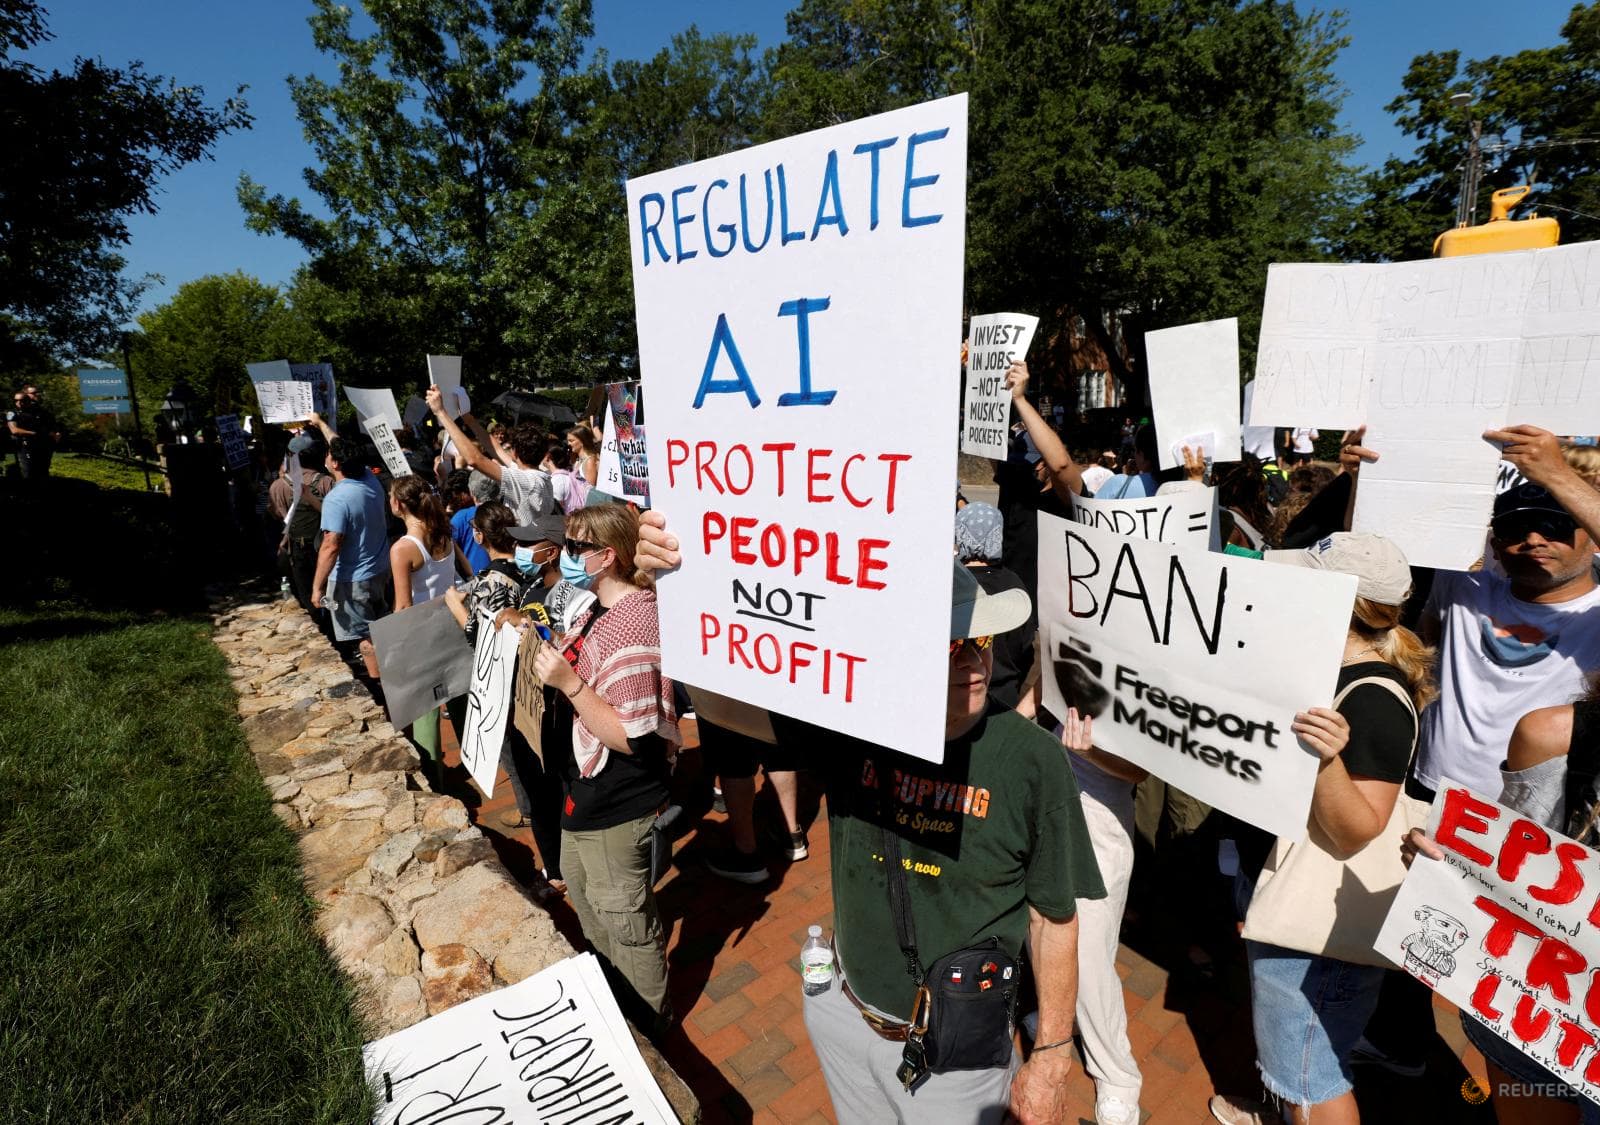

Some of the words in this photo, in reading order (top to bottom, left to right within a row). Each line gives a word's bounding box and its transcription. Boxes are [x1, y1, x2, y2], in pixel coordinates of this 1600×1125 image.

[638, 127, 950, 267] REGULATE
[692, 295, 838, 409] AI
[974, 324, 1026, 346] INVEST
[972, 352, 983, 371] IN
[985, 351, 1015, 371] JOBS
[970, 401, 1005, 423] MUSK'S
[621, 438, 646, 455] what
[968, 427, 1004, 446] POCKETS
[608, 468, 618, 483] is
[666, 439, 913, 514] PROTECT
[702, 511, 891, 591] PEOPLE
[732, 579, 826, 621] NOT
[700, 612, 867, 703] PROFIT
[1114, 664, 1280, 750] Freeport
[1112, 698, 1264, 784] Markets
[862, 759, 990, 819] OUPYING
[911, 811, 956, 834] Space
[914, 862, 941, 877] now
